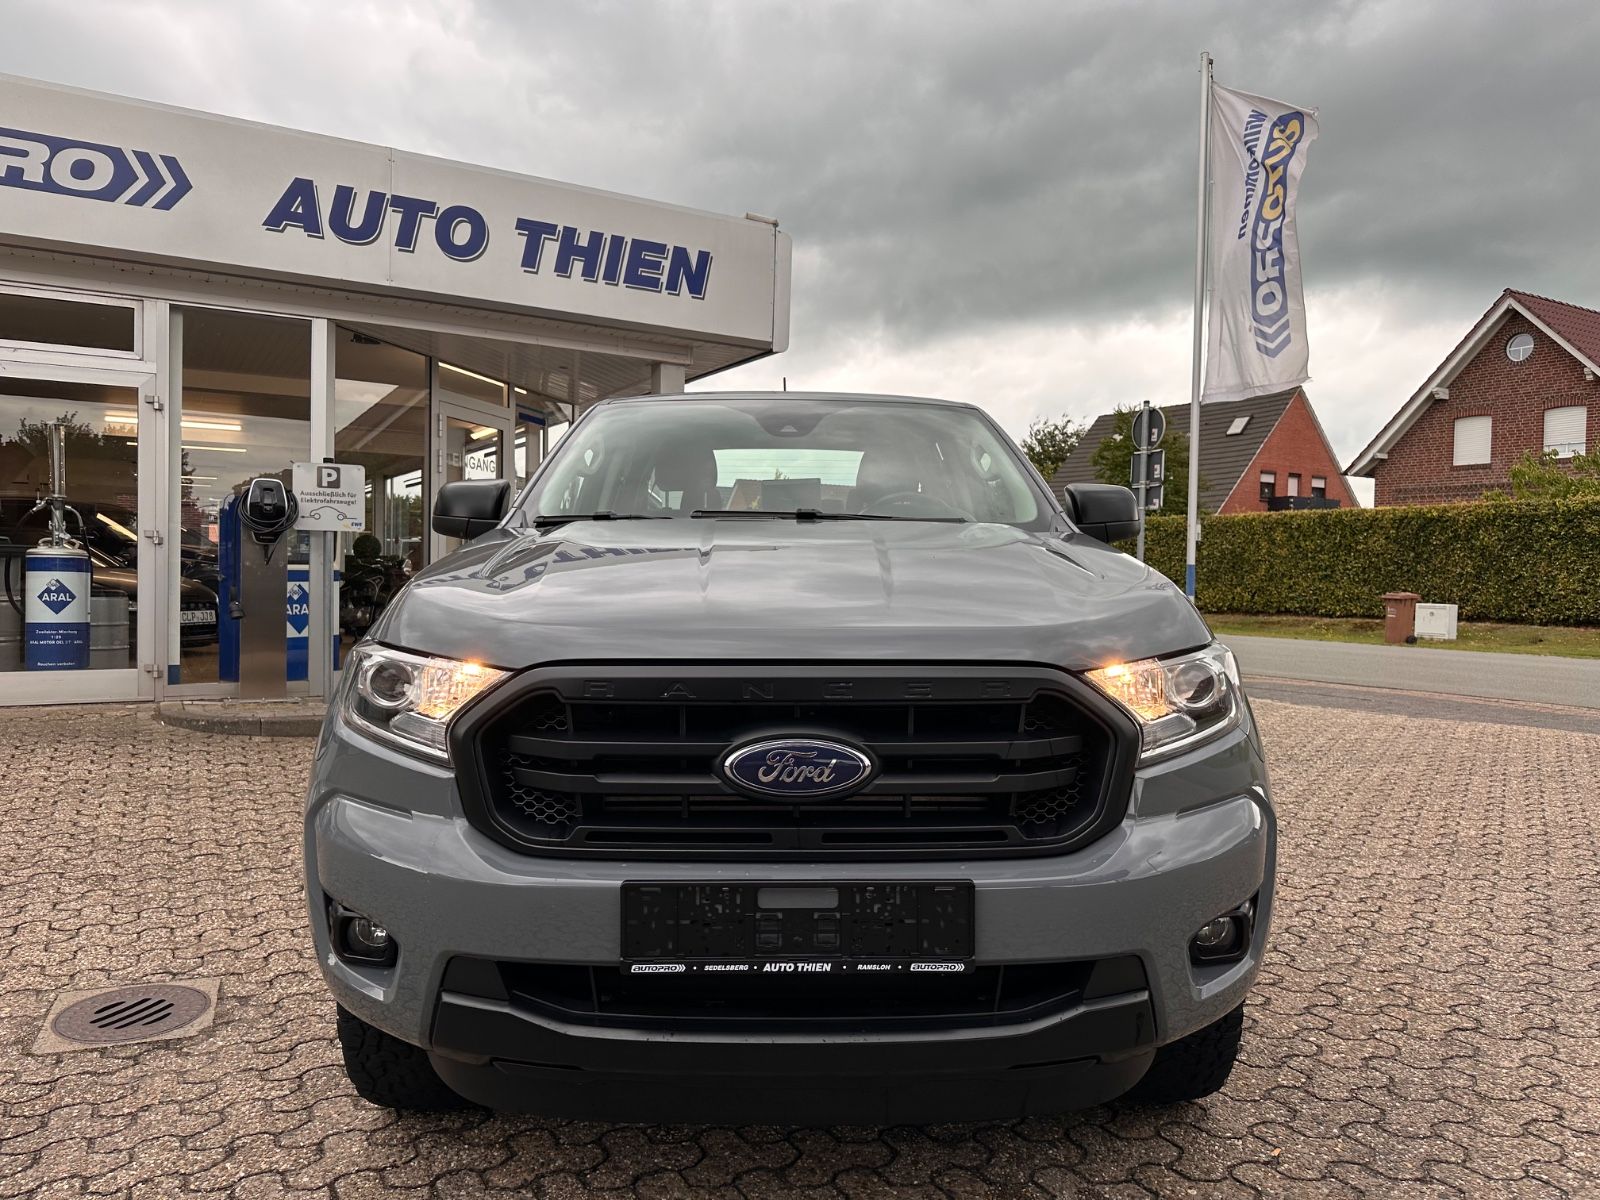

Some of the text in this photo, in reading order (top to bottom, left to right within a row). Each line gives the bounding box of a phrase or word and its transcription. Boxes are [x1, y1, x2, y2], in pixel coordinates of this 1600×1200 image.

[262, 177, 714, 300] AUTO THIEN
[321, 468, 338, 487] P
[347, 491, 357, 499] für
[41, 592, 73, 602] ARAL
[287, 603, 309, 616] ARA
[583, 680, 1012, 699] RANGER
[758, 750, 837, 784] Ford
[763, 962, 795, 972] AUTO
[796, 962, 832, 972] THIEN
